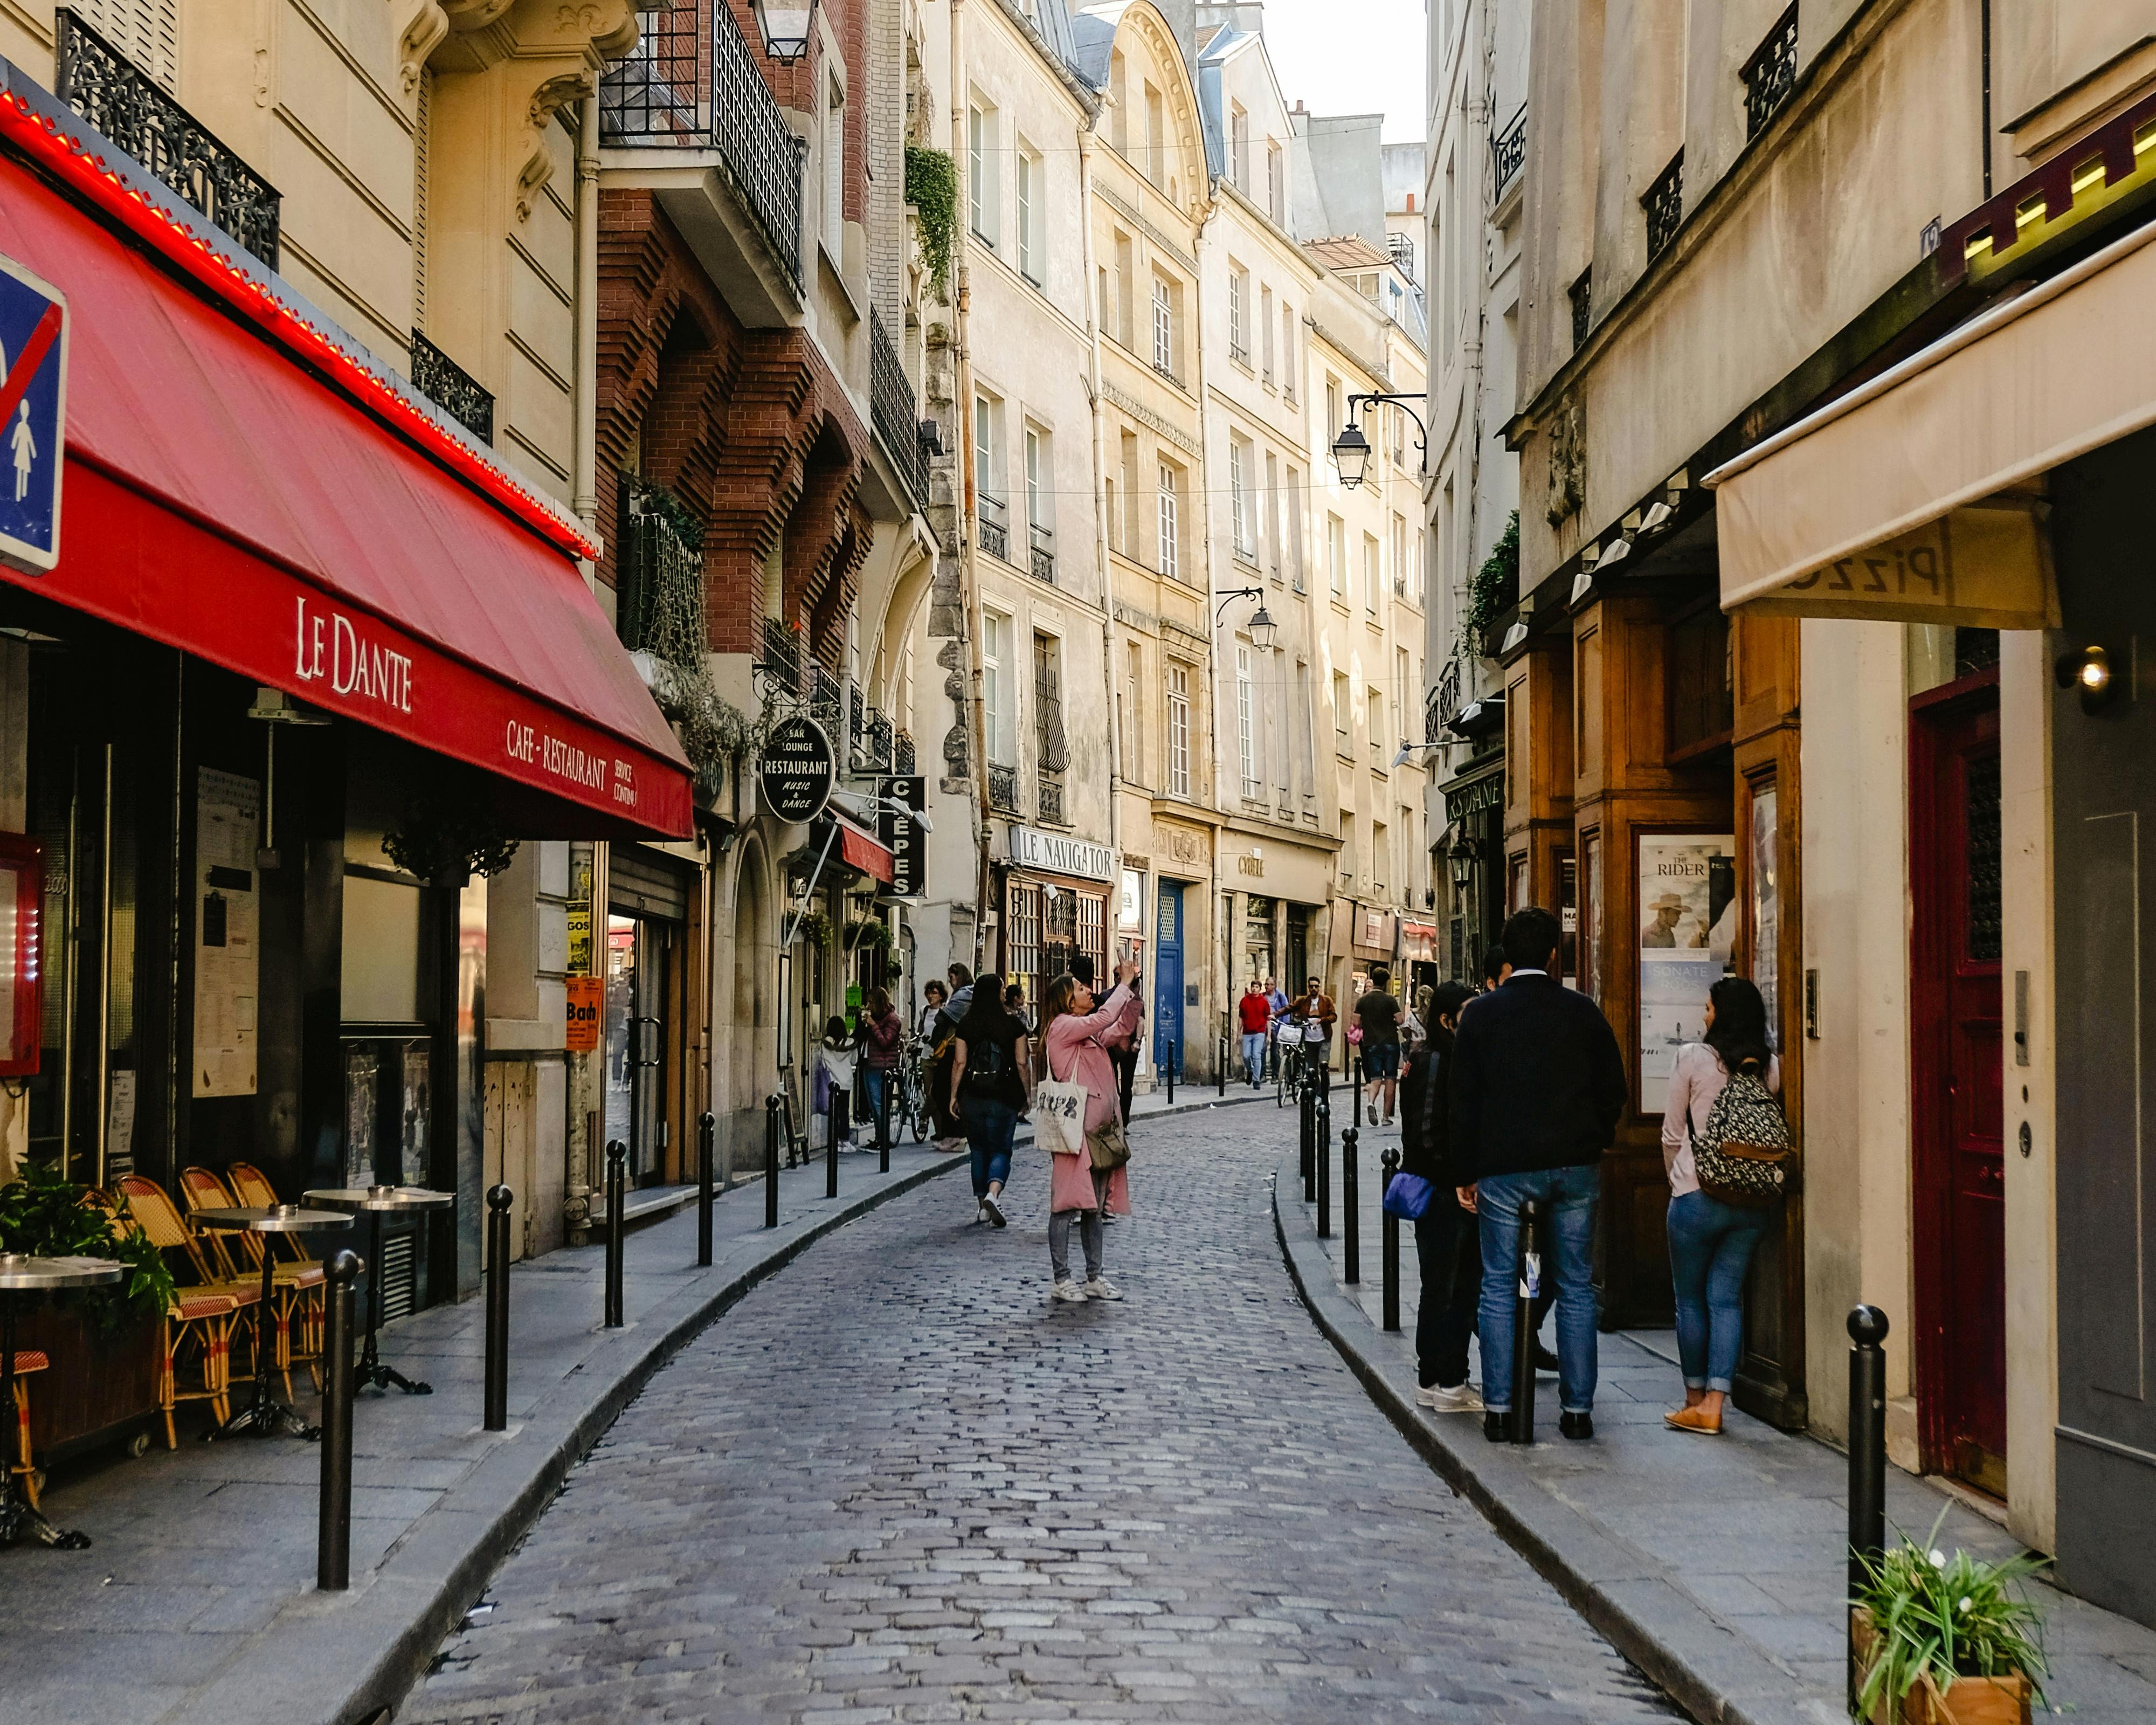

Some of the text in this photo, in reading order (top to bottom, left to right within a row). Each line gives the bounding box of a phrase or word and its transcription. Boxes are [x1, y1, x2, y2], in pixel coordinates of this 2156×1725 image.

[295, 597, 412, 714] LE DANTE
[789, 729, 805, 738] BAR
[782, 742, 813, 751] LOUNGE
[543, 734, 606, 791] RESTAURANT
[765, 761, 828, 775] RESTAURANT
[782, 781, 811, 791] MUSIC
[1449, 776, 1499, 819] RSTORANTE
[782, 799, 812, 809] DANCE
[892, 780, 910, 895] CÊPES
[1022, 832, 1112, 877] LE NAVIGATOR
[1658, 864, 1704, 875] RIDER
[568, 921, 589, 930] GOS
[1653, 966, 1708, 977] SONATE
[566, 1001, 597, 1021] Bach
